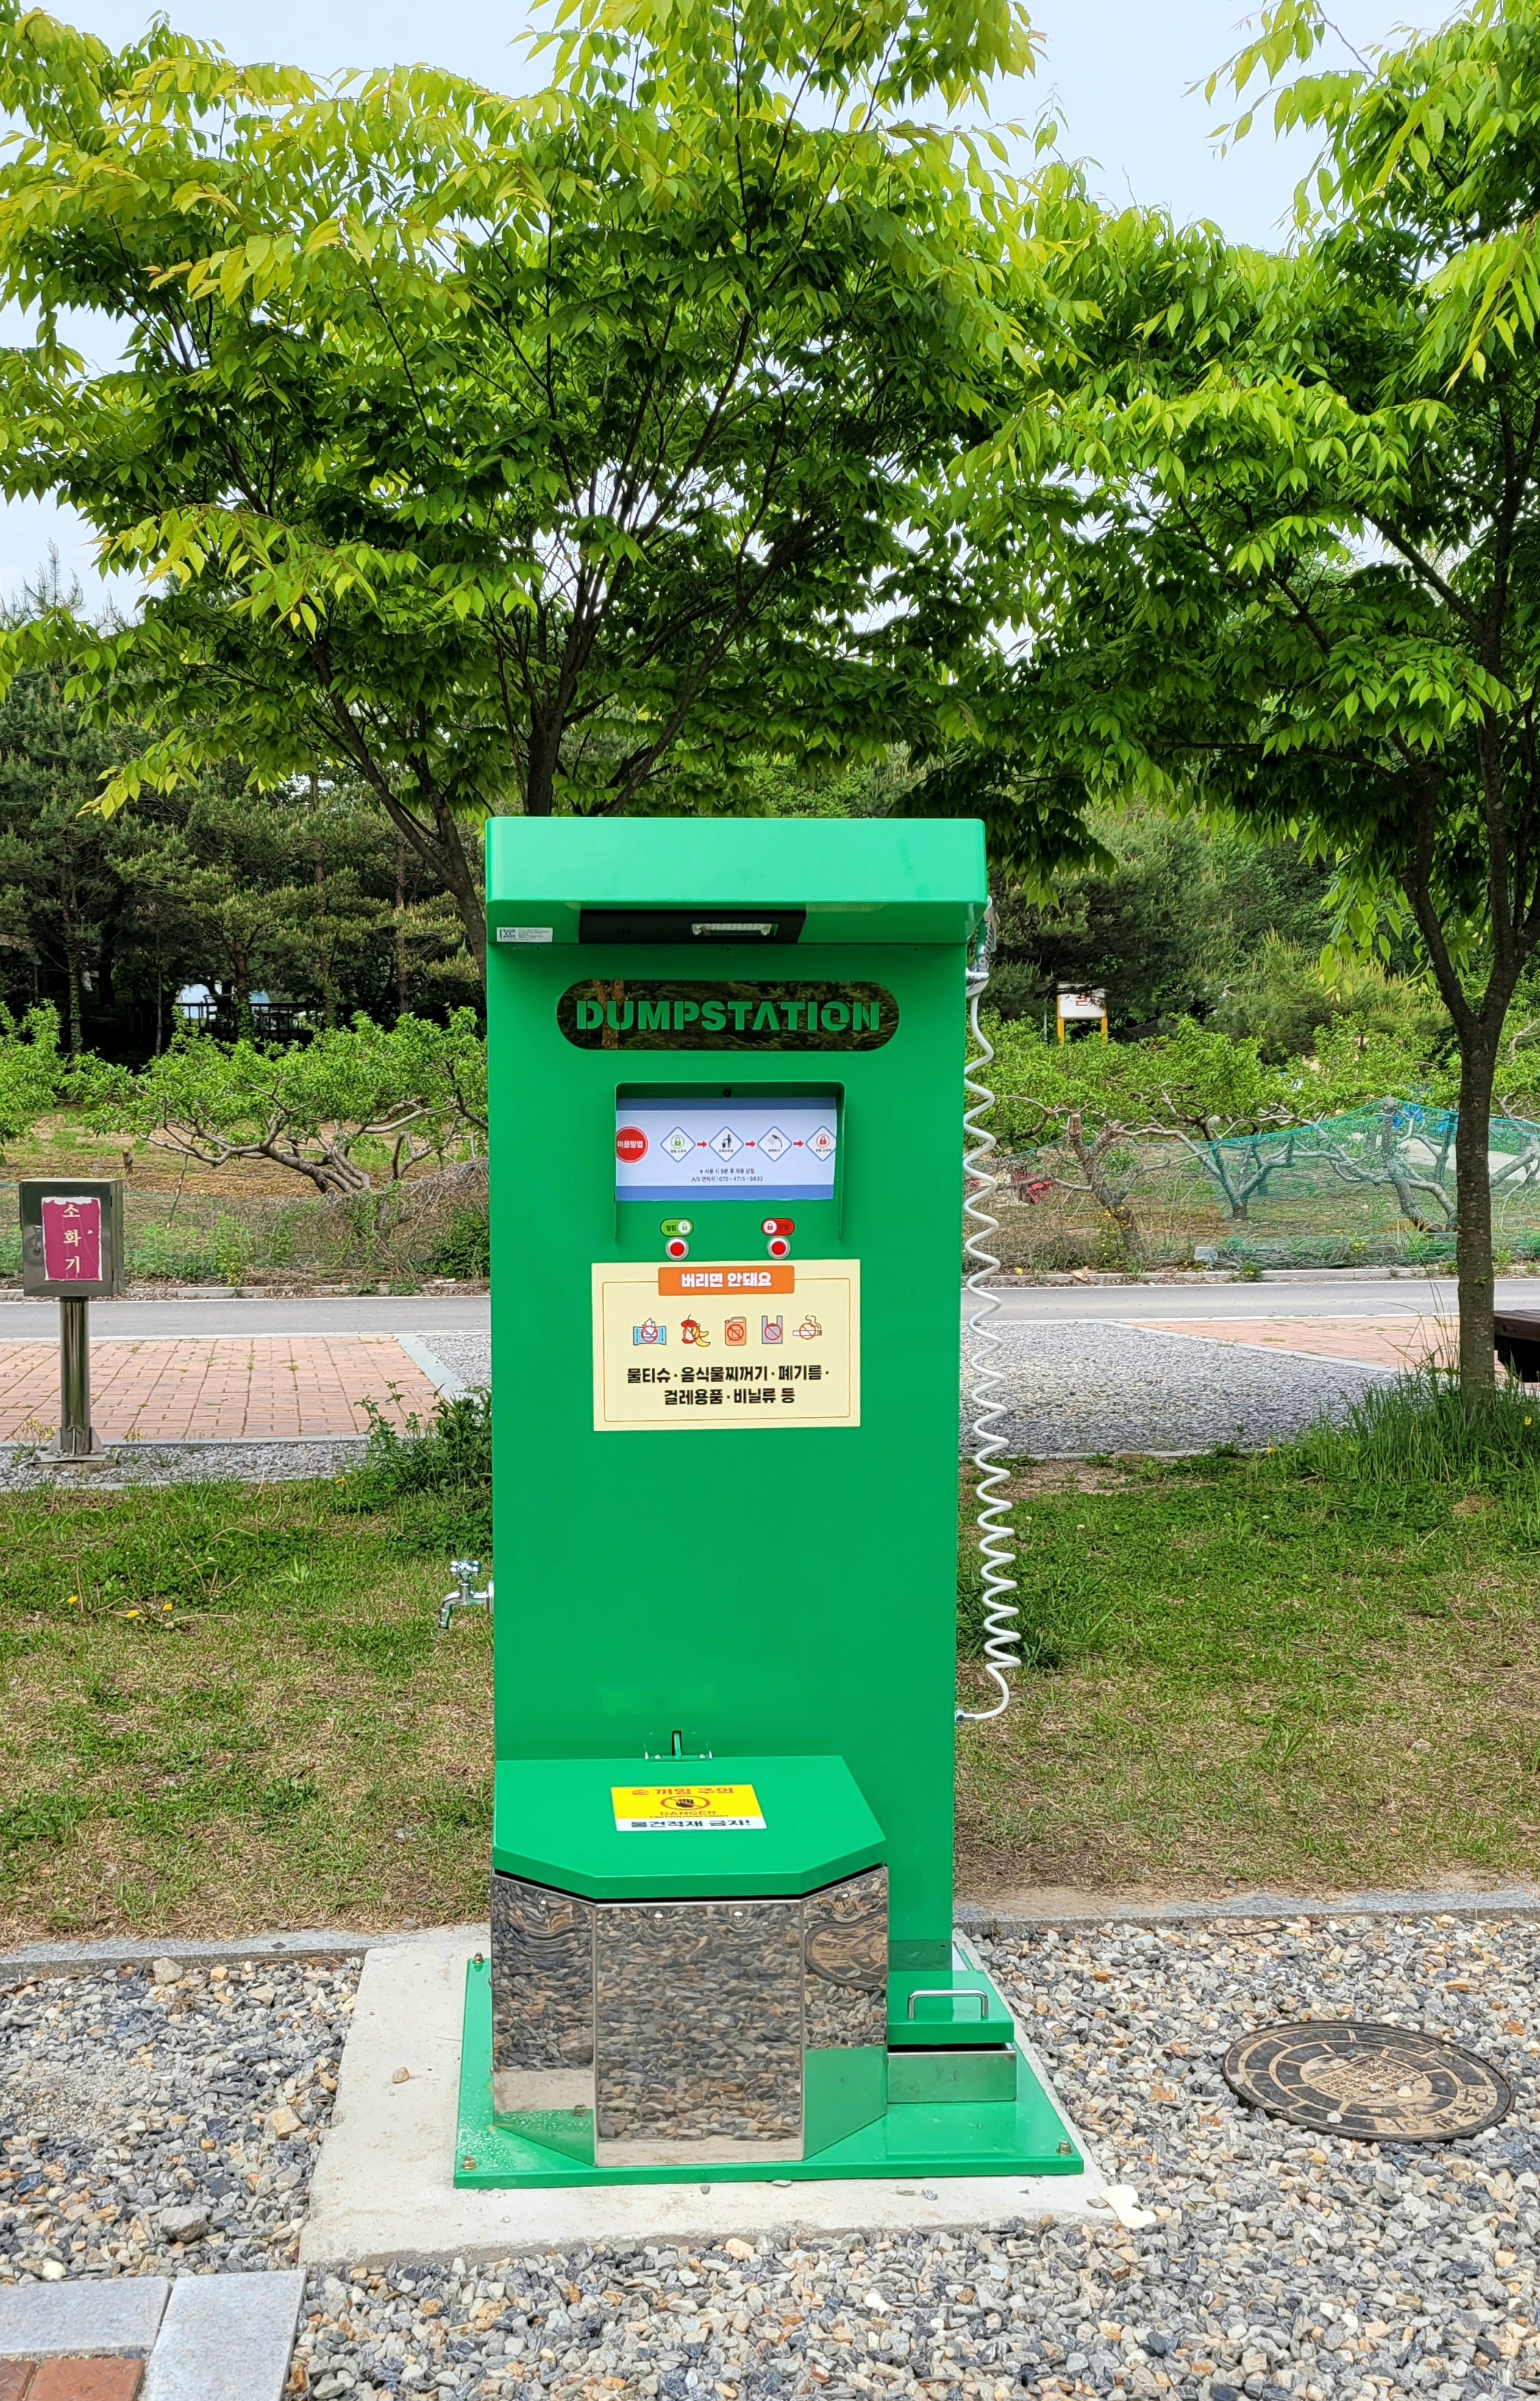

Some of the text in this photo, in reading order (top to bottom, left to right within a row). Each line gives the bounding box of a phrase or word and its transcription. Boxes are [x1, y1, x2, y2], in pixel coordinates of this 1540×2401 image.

[576, 1000, 880, 1031] DUMPSTATION
[617, 1140, 644, 1149] 이용방법
[681, 1271, 772, 1288] 버리면 안돼요
[781, 1388, 796, 1404] 등
